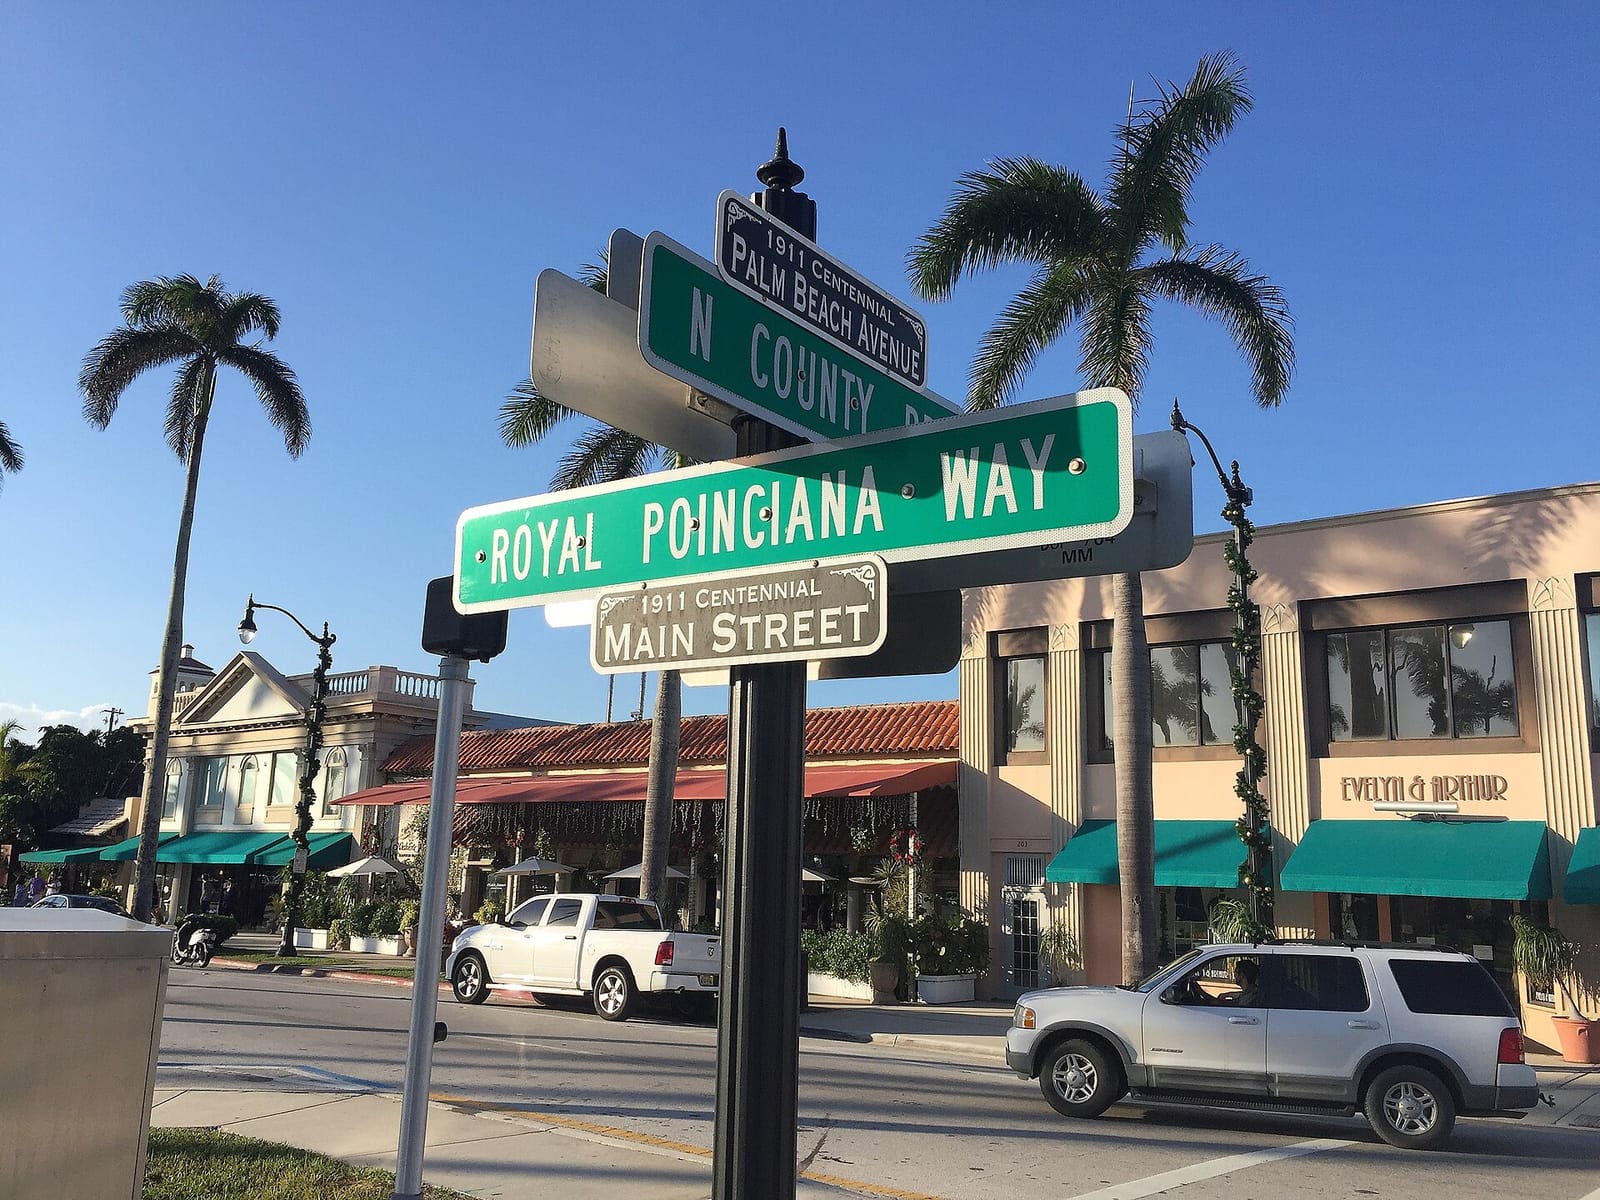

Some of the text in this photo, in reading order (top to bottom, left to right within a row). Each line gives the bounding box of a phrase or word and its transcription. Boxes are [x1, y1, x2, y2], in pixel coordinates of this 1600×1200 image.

[730, 231, 921, 381] PALM BEACH AVENUE
[766, 228, 895, 327] 1911 CENTENNIAL
[689, 286, 875, 434] N COUNTY
[490, 433, 1056, 585] ROYAL POINCIANA WAY
[641, 577, 823, 616] 1911 CENTENNIAL
[1061, 548, 1094, 565] MM
[603, 603, 870, 664] MAIN STREET
[1340, 774, 1509, 803] EVELYN & ARTHUR
